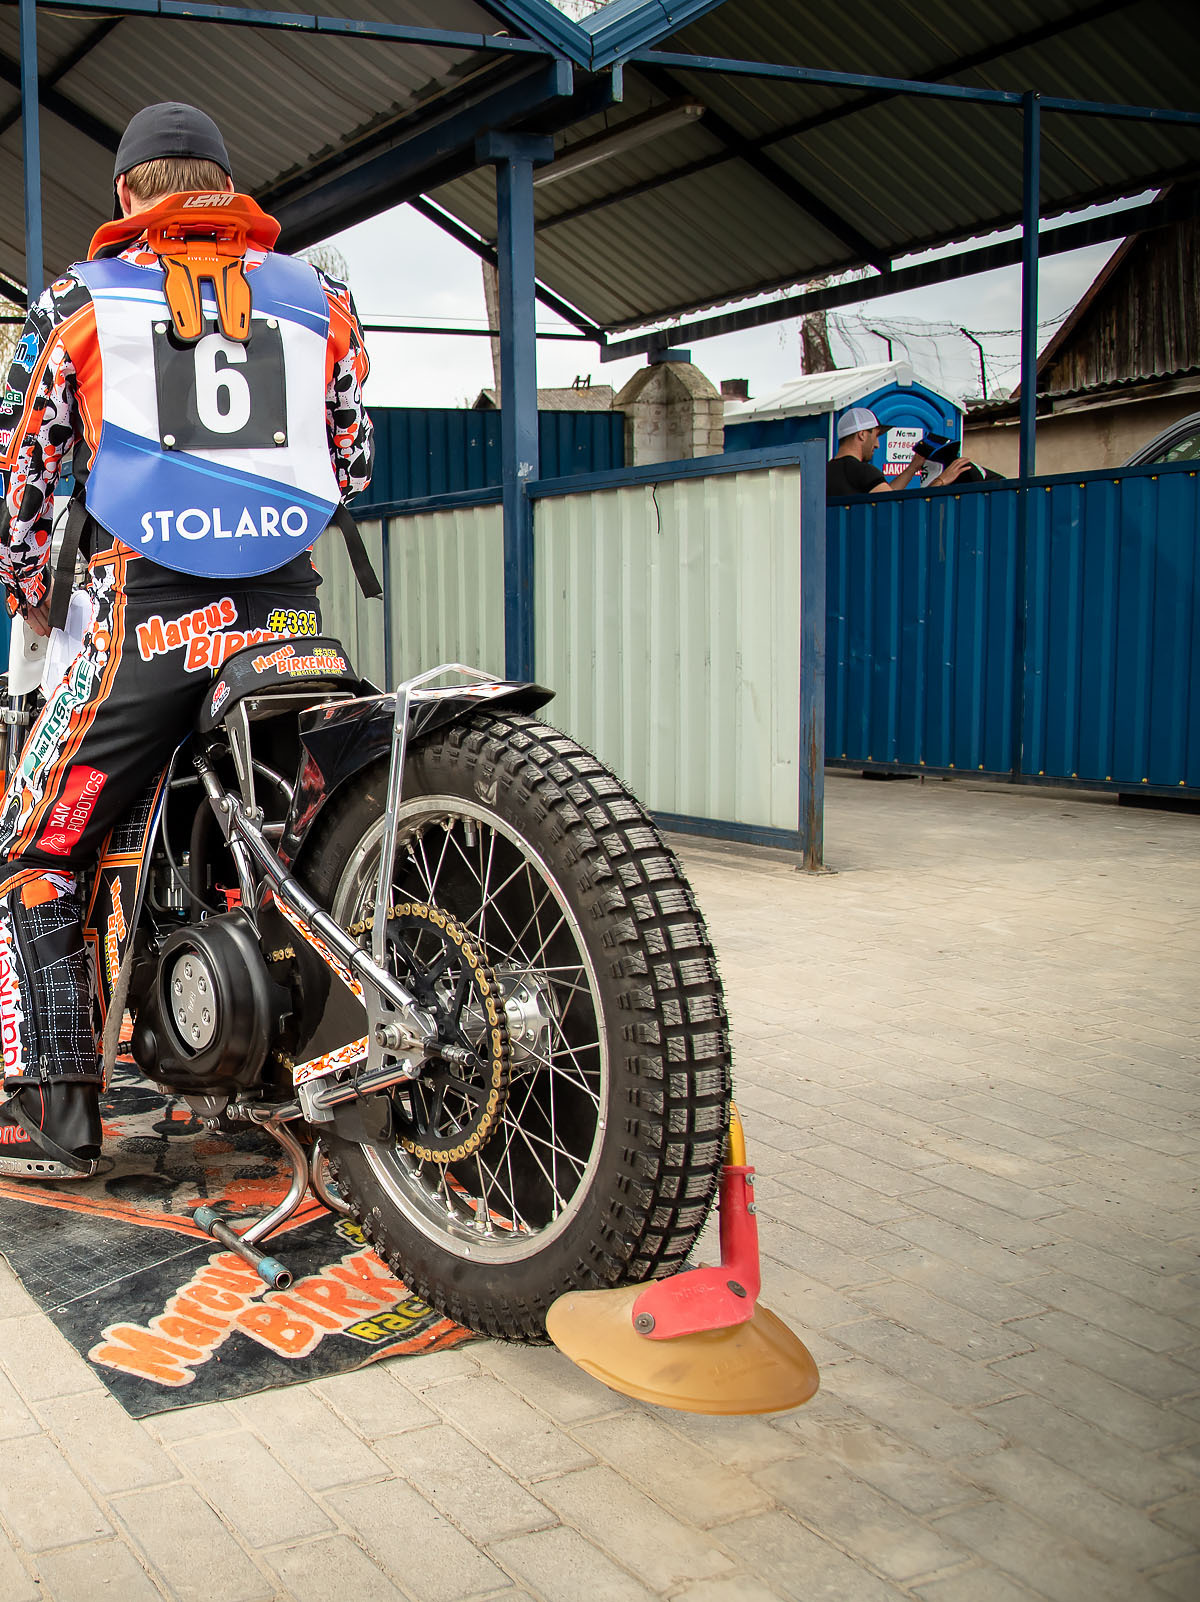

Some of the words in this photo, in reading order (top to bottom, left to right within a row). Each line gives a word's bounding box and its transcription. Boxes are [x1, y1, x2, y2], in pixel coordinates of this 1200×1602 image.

[183, 193, 238, 208] LEATT
[194, 332, 250, 434] 6
[140, 506, 308, 543] STOLARO
[136, 598, 237, 661] Marcus
[268, 609, 317, 636] #335
[252, 645, 295, 673] Marcus
[277, 656, 347, 674] BIRKEMOSE
[67, 770, 104, 832] ROBOTICS
[50, 803, 72, 828] DAN
